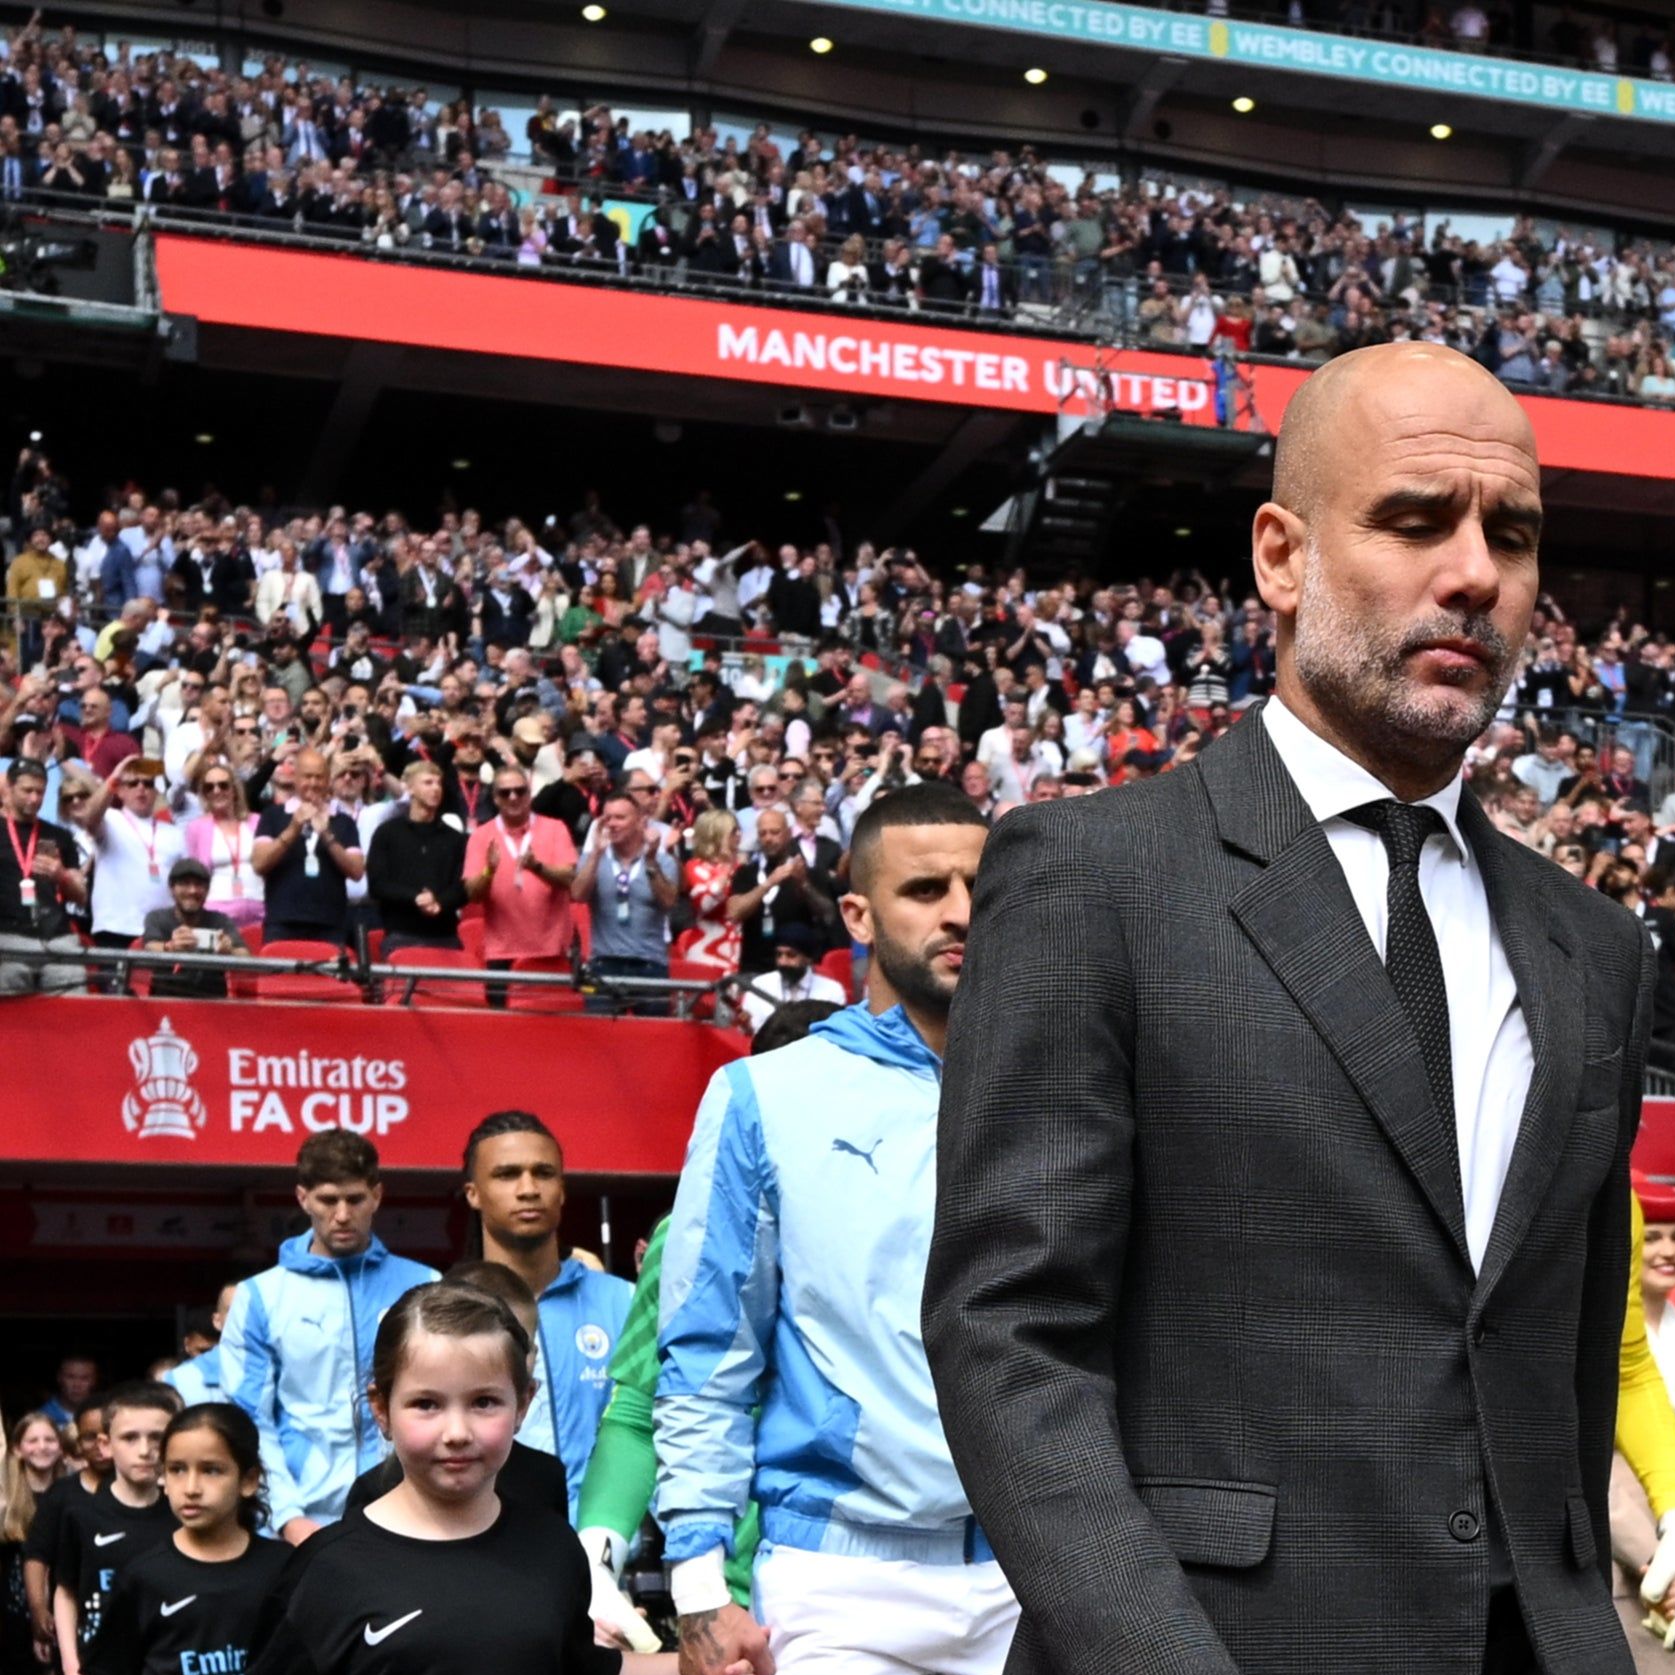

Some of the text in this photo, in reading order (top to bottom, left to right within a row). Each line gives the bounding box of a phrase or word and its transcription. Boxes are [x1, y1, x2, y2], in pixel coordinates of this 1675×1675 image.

[1128, 16, 1166, 40] BY
[1170, 22, 1202, 48] EE
[1235, 30, 1366, 68] WEMBLEY
[1371, 50, 1539, 94] CONNECTED
[1542, 75, 1577, 99] BY
[717, 323, 1209, 412] MANCHESTER UNITED
[227, 1048, 408, 1090] Emirates
[230, 1089, 409, 1136] FA CUP
